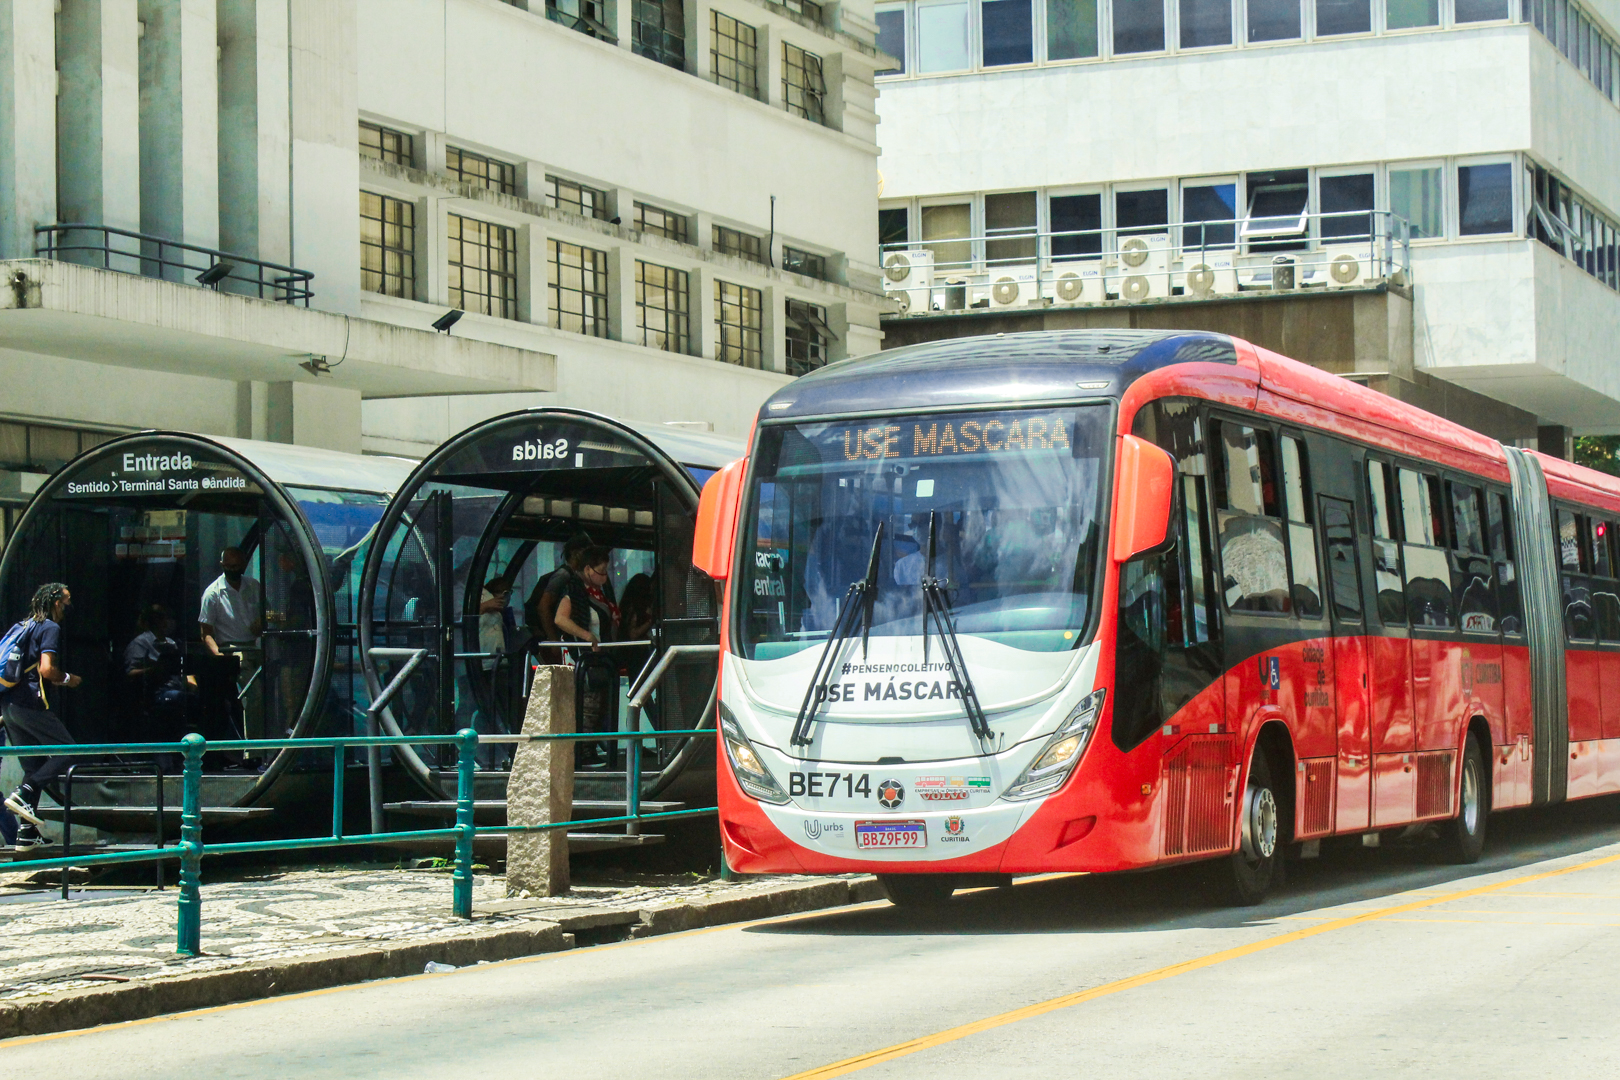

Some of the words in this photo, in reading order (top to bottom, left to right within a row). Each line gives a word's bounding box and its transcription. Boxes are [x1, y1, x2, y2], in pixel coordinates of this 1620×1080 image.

[844, 426, 900, 460] USE
[914, 417, 1070, 456] MASCARA
[123, 451, 193, 472] Entrada
[68, 481, 110, 494] Sentido
[120, 479, 165, 492] Terminal
[168, 478, 199, 490] Santa
[841, 662, 950, 675] #PENSENOCOLETIVO
[790, 772, 872, 798] BE714
[920, 792, 969, 800] VOLVO
[824, 822, 844, 832] urbs
[863, 832, 918, 846] BBZ9F99
